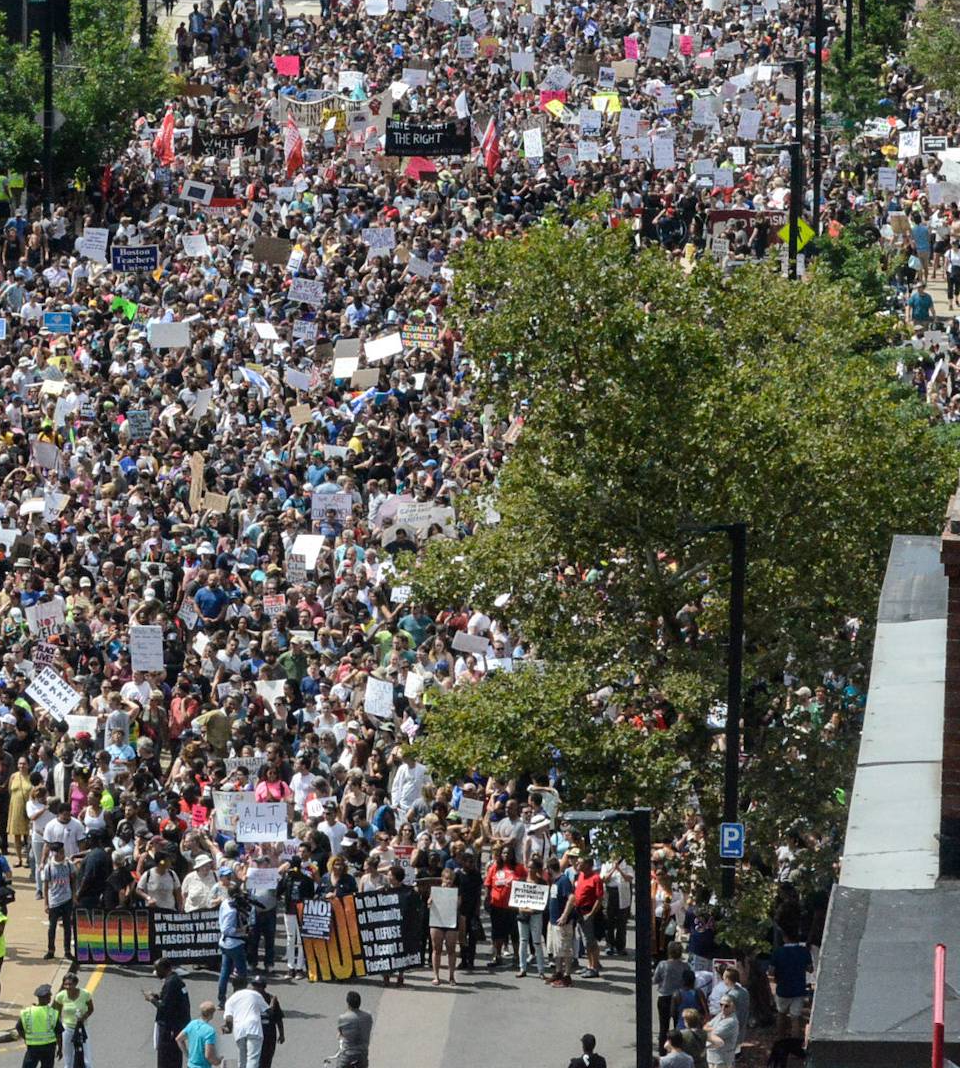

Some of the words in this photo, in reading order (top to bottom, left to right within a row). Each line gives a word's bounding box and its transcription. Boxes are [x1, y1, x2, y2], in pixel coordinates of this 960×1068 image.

[202, 137, 245, 149] WHITE
[394, 133, 411, 145] THE
[413, 133, 443, 145] RIGHT
[120, 248, 150, 256] Boston
[117, 256, 155, 264] Teachers
[36, 616, 56, 627] NOT
[37, 643, 54, 654] BLACK
[44, 668, 56, 680] NO
[38, 675, 49, 686] NO
[49, 686, 68, 704] KKK
[244, 804, 279, 818] ALT
[239, 821, 281, 837] REALITY
[723, 827, 740, 848] P
[303, 899, 332, 917] ¡NO!
[355, 898, 364, 910] In
[365, 896, 377, 908] the
[378, 893, 399, 906] Name
[358, 913, 366, 924] of
[155, 924, 166, 932] WE
[168, 923, 193, 932] REFUSE
[195, 922, 204, 931] TO
[361, 930, 374, 942] We
[375, 925, 402, 940] REFUSE
[75, 909, 151, 964] NO!
[155, 935, 161, 945] A
[162, 934, 195, 944] FASCIST
[296, 895, 366, 981] NO!
[364, 944, 373, 956] To
[374, 943, 397, 956] Accept
[398, 942, 404, 952] a
[366, 958, 391, 973] Fascist
[391, 952, 422, 969] America!
